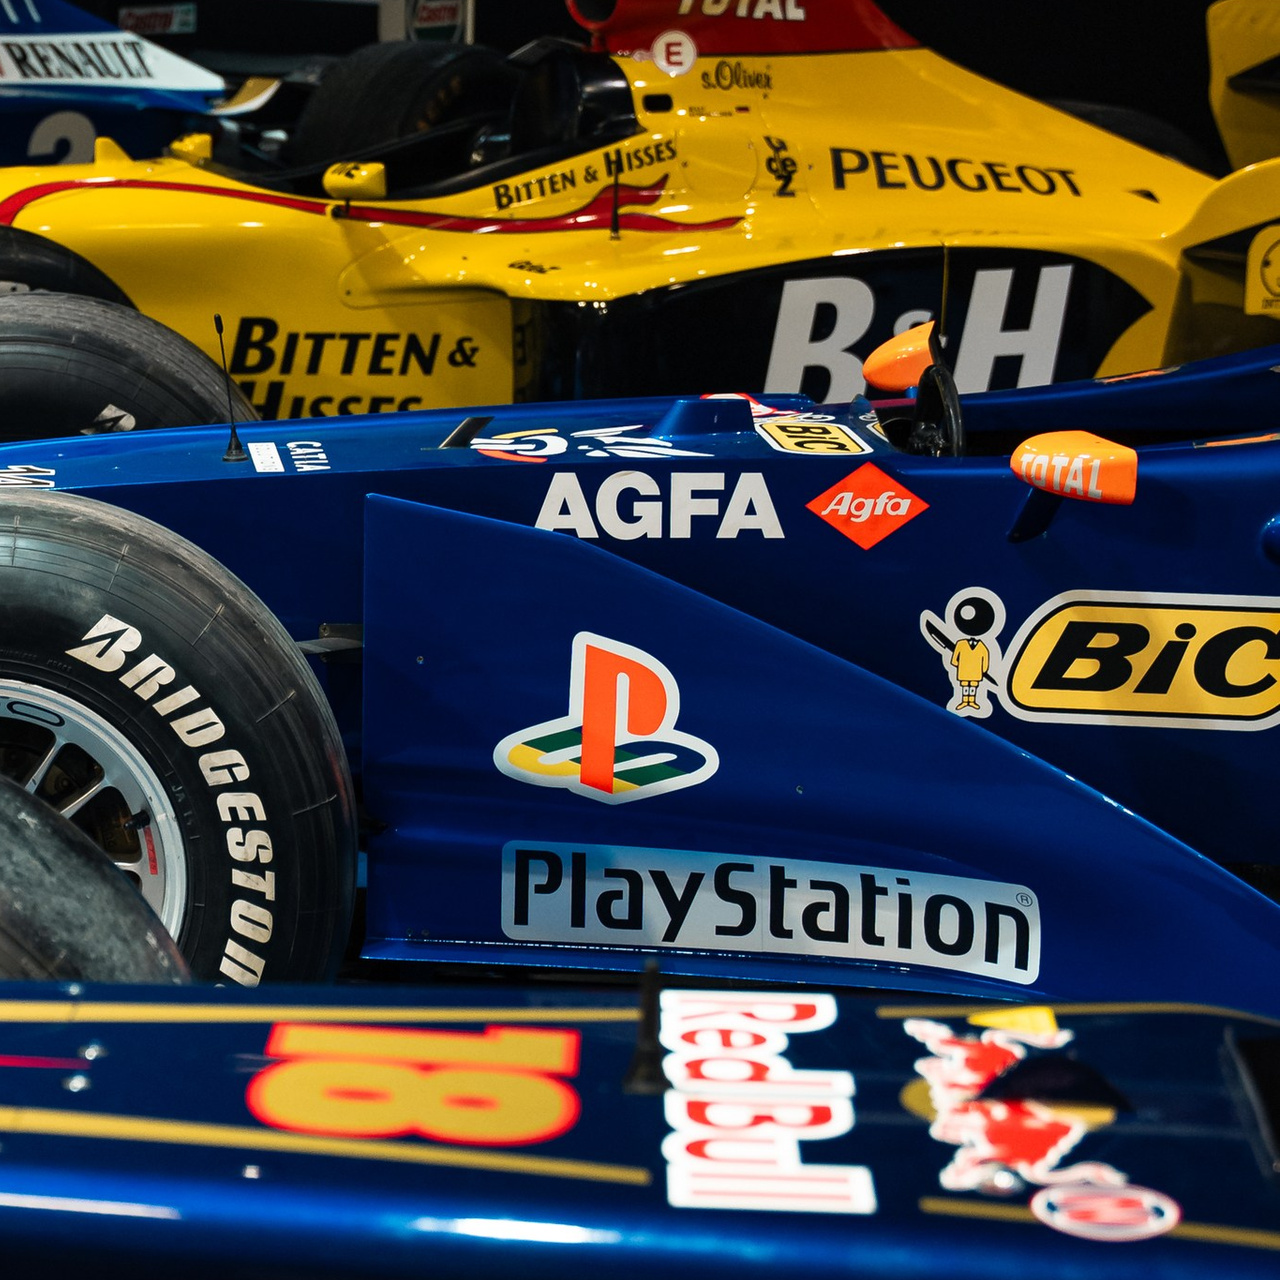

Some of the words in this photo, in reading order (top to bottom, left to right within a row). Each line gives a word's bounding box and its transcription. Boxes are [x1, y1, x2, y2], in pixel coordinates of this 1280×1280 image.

[6, 39, 154, 81] RENAULT
[665, 41, 684, 66] E
[493, 166, 577, 210] BITTEN
[584, 166, 600, 184] &
[604, 138, 678, 176] HISSES
[830, 146, 1082, 197] PEUGEOT
[229, 316, 442, 377] BITTEN
[447, 335, 481, 369] &
[534, 470, 786, 541] AGFA
[821, 491, 913, 523] Agfa
[1019, 453, 1103, 500] TOTAL
[65, 613, 276, 988] BRIDGESTON
[513, 848, 1032, 973] PlayStation
[246, 1022, 581, 1146] 18
